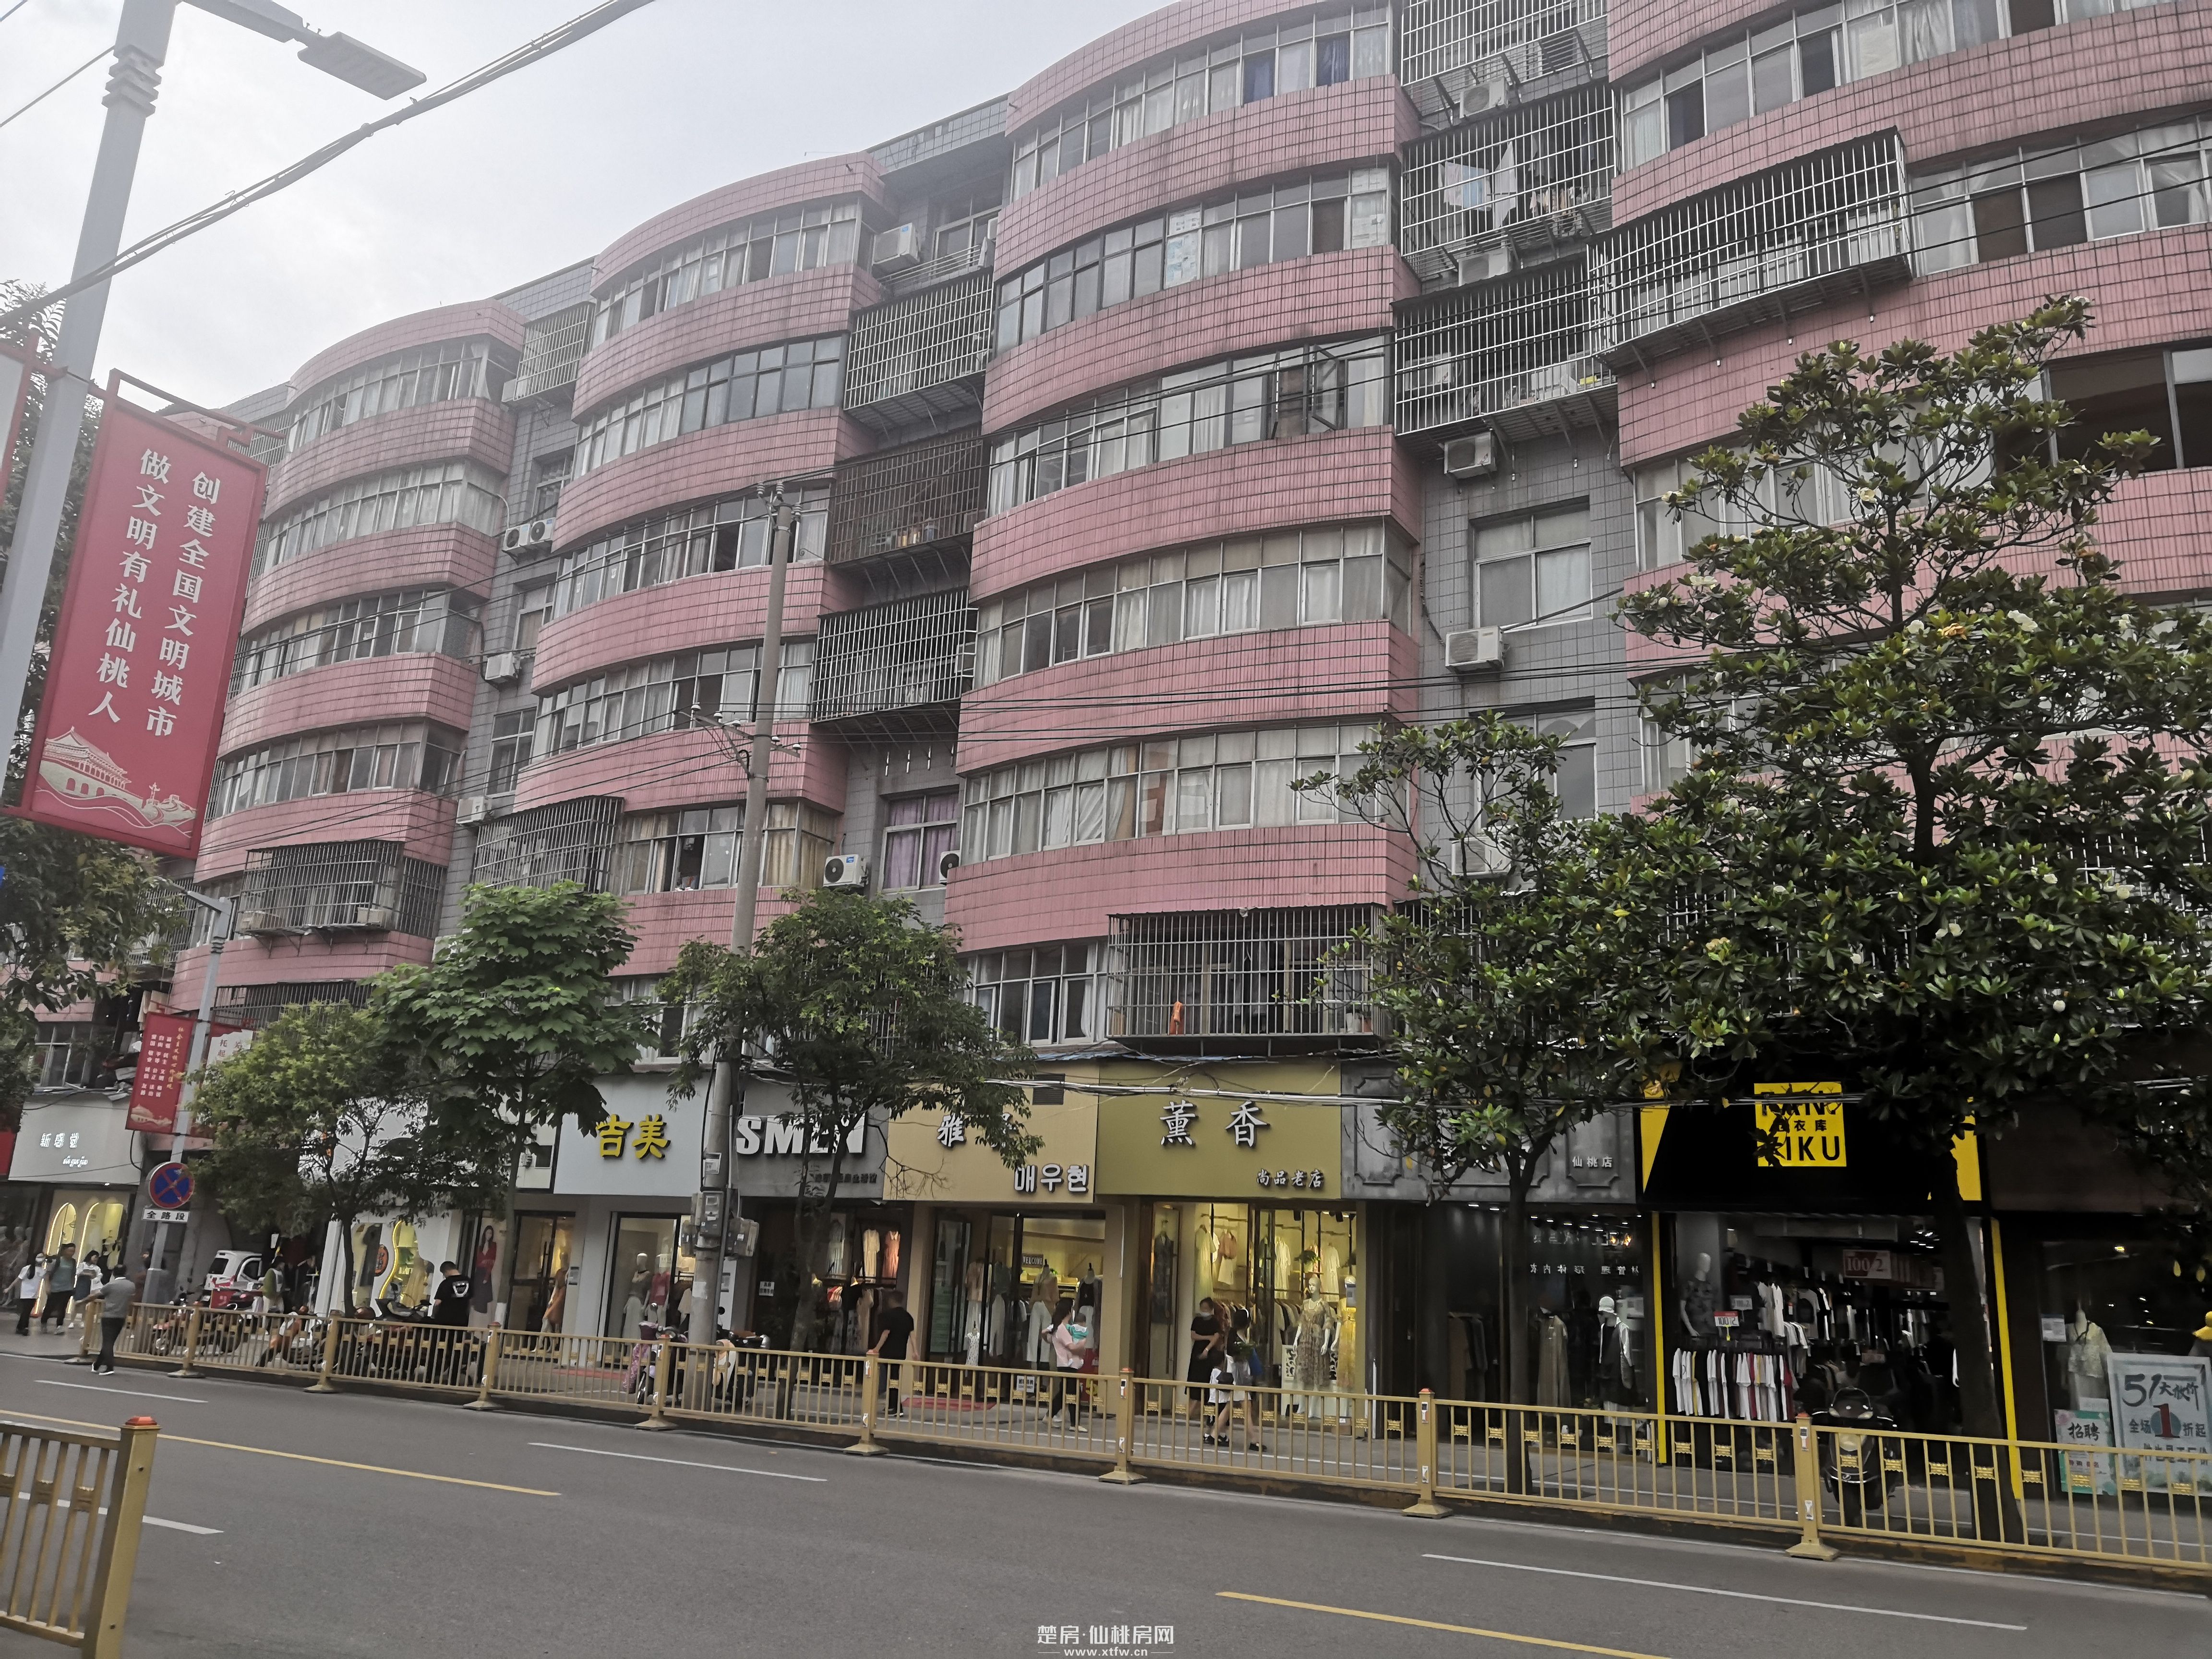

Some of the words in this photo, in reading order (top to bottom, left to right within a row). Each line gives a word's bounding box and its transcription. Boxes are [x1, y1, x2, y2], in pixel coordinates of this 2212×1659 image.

[88, 448, 171, 723] 做文明有礼仙桃人
[145, 471, 220, 736] 创建全国文明城市
[1159, 1099, 1270, 1147] 薰香
[40, 1132, 79, 1148] 新感觉
[595, 1113, 670, 1159] 吉美
[1767, 1136, 1840, 1161] IKU
[1572, 1155, 1613, 1168] 仙桃店
[1014, 1164, 1089, 1192] 매우현
[1257, 1168, 1324, 1188] 尚品老店
[146, 1210, 185, 1220] 全路段
[2068, 1422, 2100, 1441] 招聘
